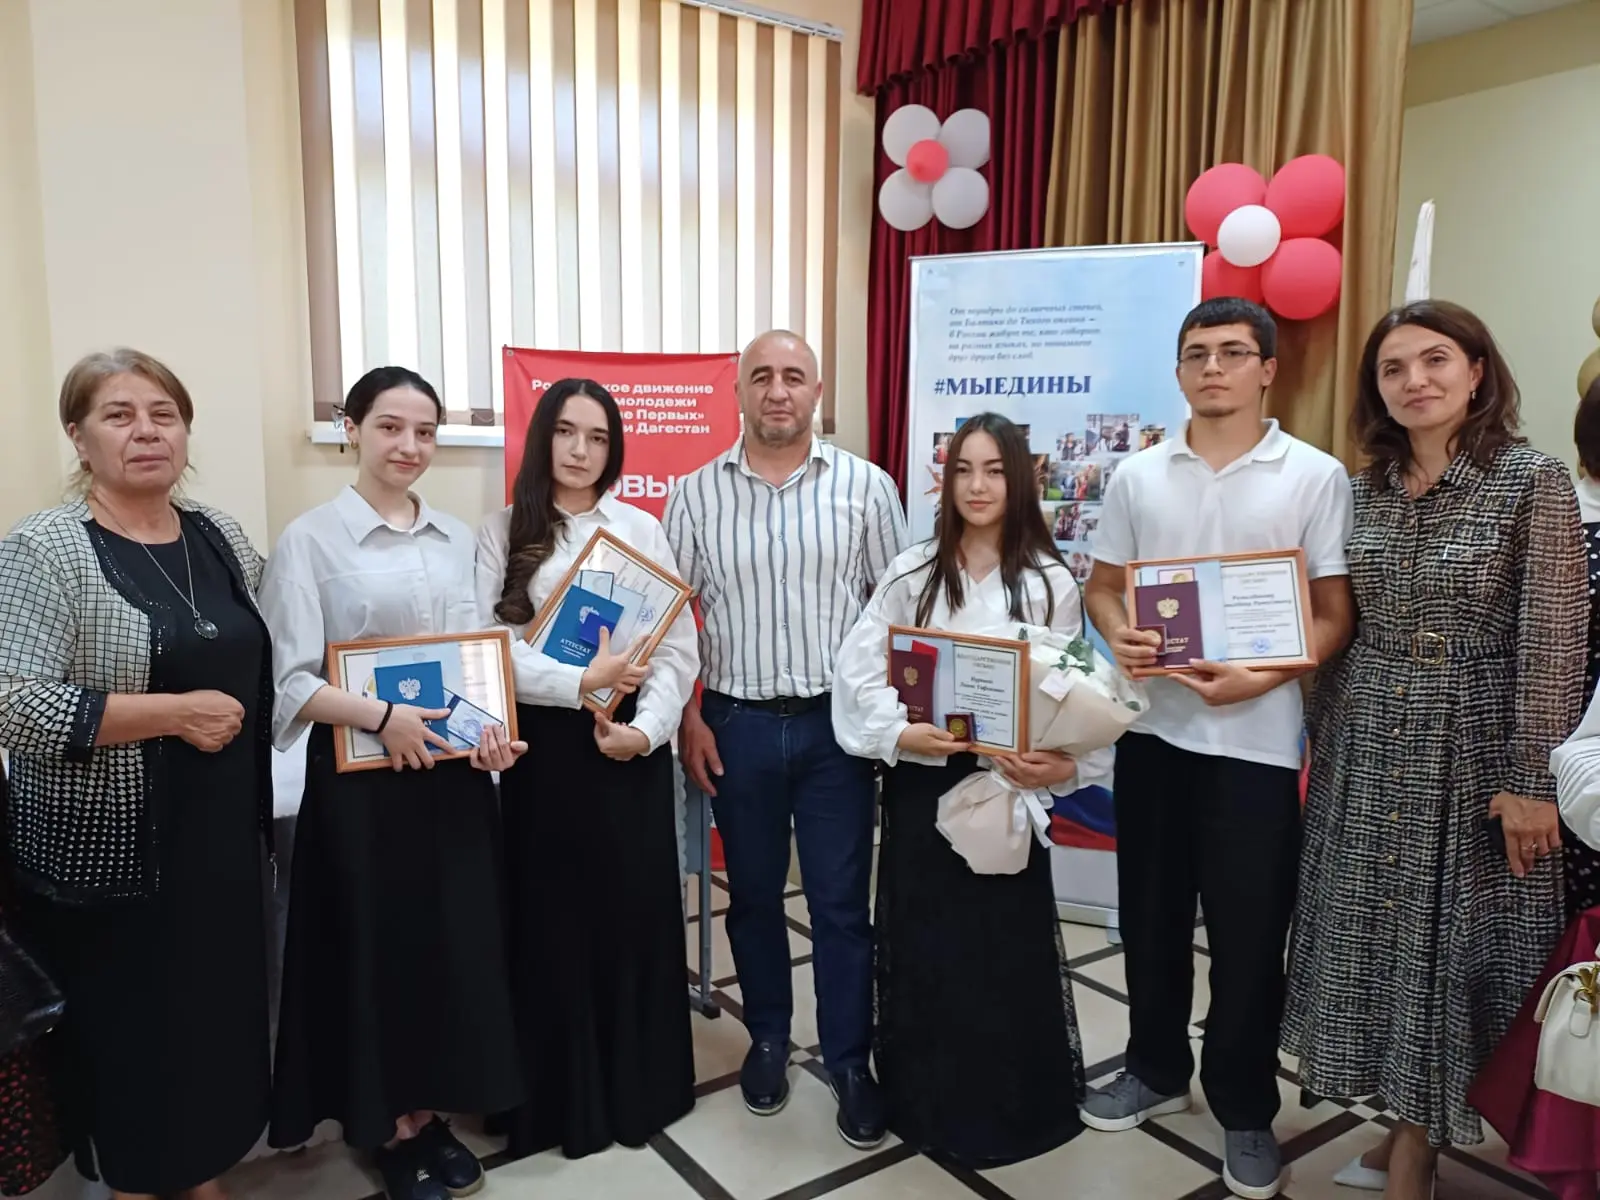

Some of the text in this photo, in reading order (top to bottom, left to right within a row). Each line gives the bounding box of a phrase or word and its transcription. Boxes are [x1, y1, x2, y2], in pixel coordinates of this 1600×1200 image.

[632, 383, 714, 396] движение
[934, 375, 1092, 398] #МЫЕДИНЫ
[614, 397, 697, 409] молодежи
[636, 409, 705, 422] Первых»
[636, 422, 710, 435] Дагестан
